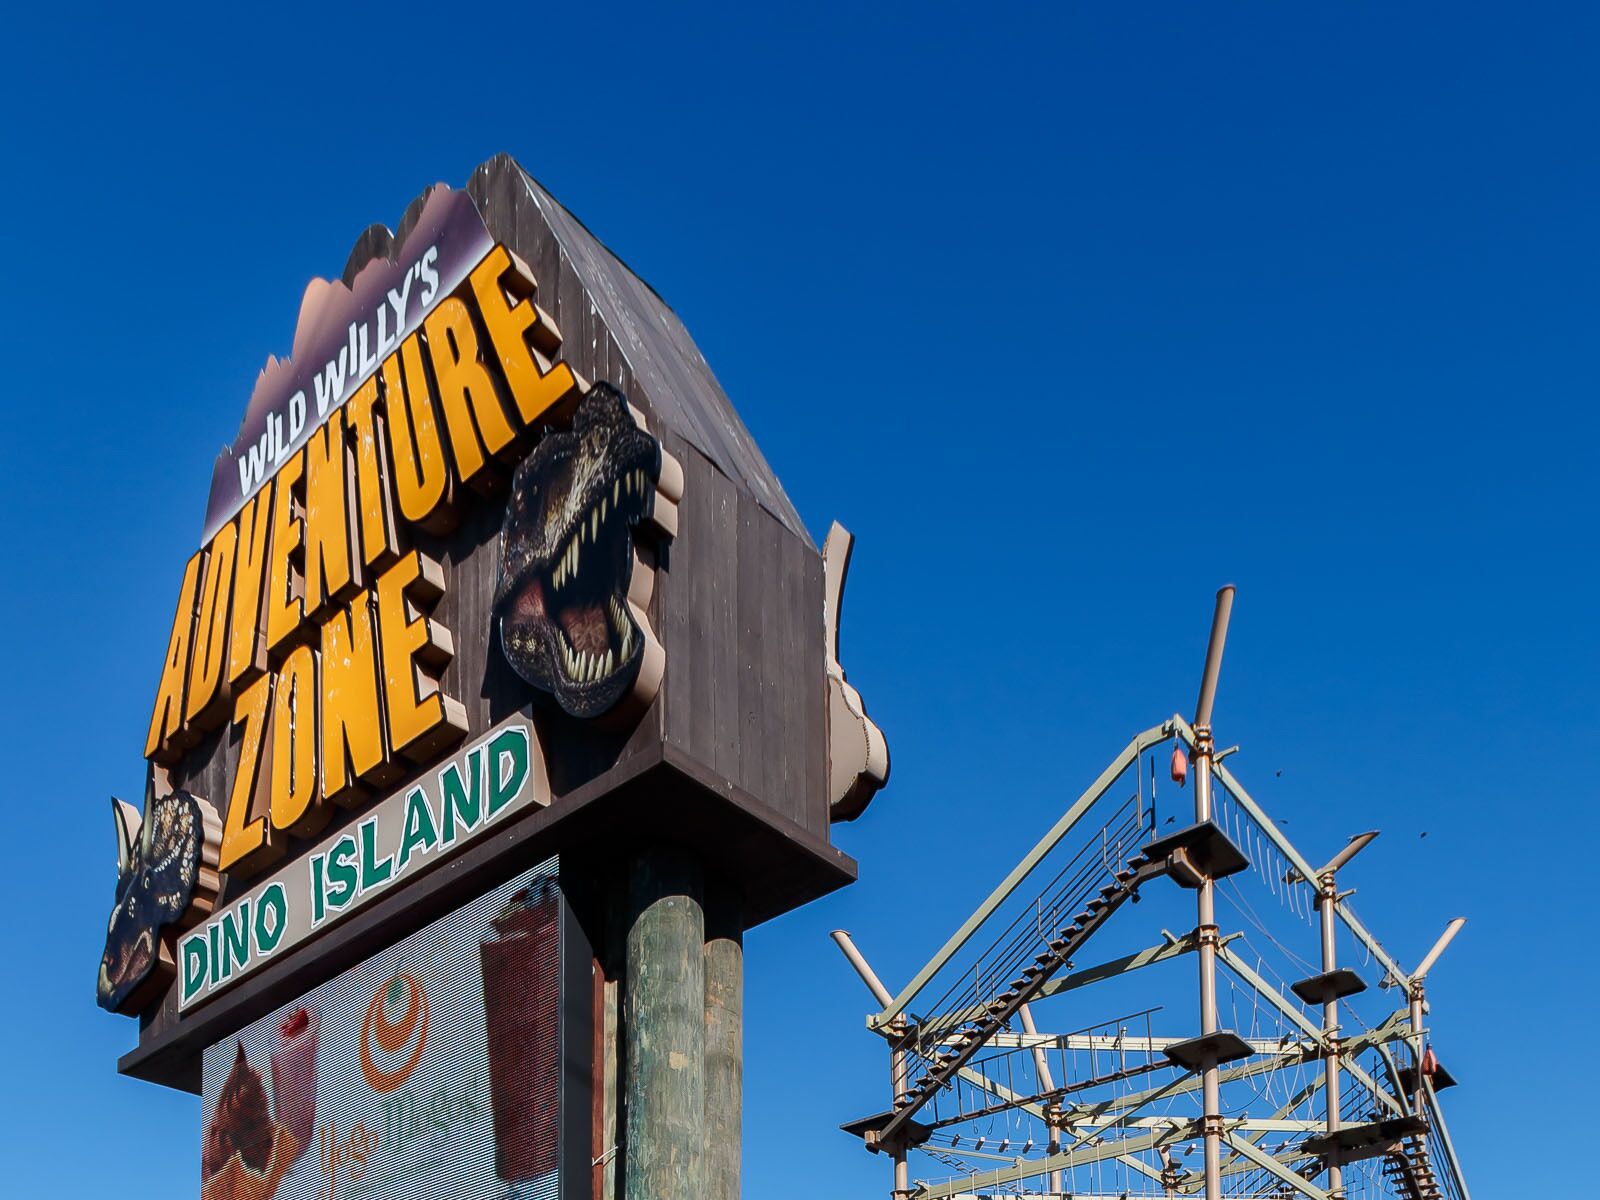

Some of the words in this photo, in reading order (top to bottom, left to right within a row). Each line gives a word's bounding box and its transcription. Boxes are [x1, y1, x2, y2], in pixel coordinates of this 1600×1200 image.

[145, 243, 575, 759] ADVENTURE
[239, 390, 306, 496] WILD
[313, 245, 439, 418] WILLY'S
[219, 550, 442, 872] ZONE
[180, 882, 288, 1007] DINO
[309, 725, 531, 929] ISLAND
